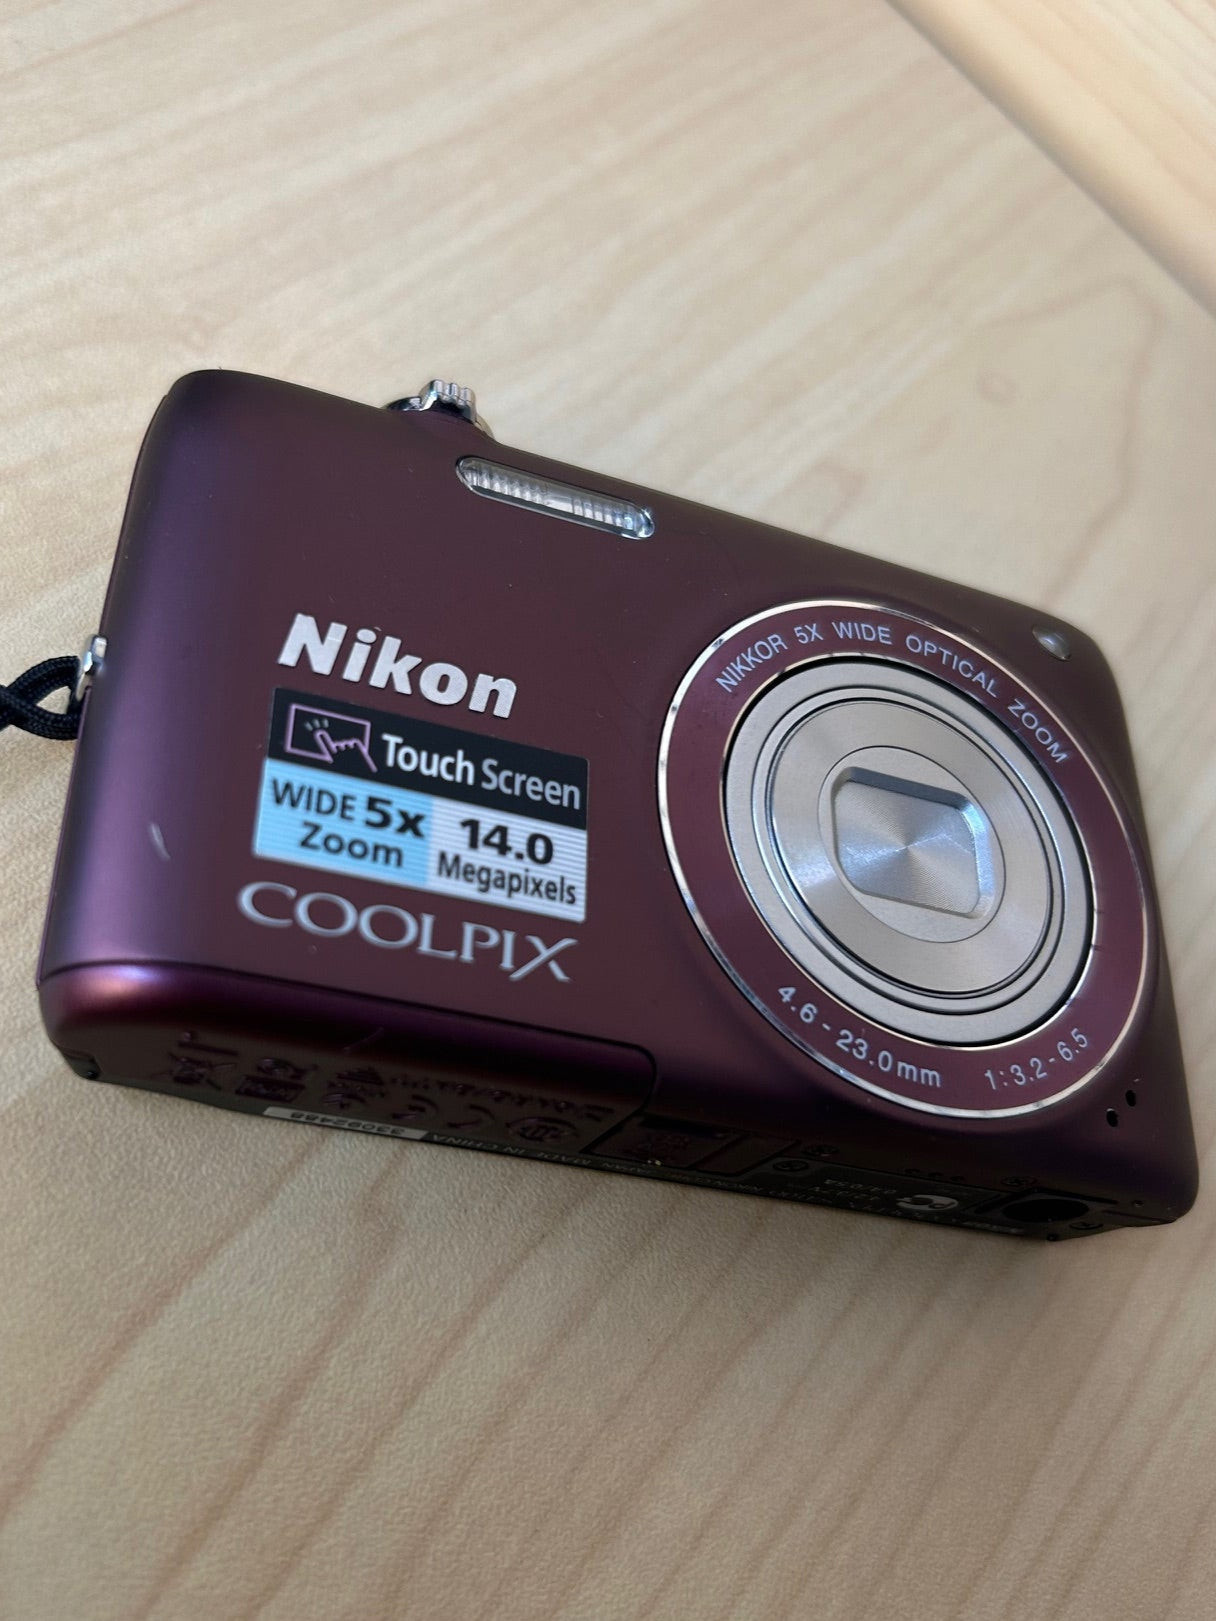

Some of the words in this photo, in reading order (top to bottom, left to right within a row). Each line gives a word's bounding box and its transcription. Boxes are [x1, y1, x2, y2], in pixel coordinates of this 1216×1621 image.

[277, 613, 518, 718] Nikon
[715, 633, 788, 693] NIKKOR
[794, 623, 824, 644] 5X
[831, 621, 892, 645] WIDE
[905, 634, 998, 698] OPTICAL
[1007, 698, 1068, 763] ZOOM
[381, 733, 475, 786] Touch
[481, 758, 581, 810] Screen
[271, 777, 358, 821] WIDE
[364, 796, 426, 839] 5x
[459, 817, 554, 865] 14.0
[300, 821, 402, 869] Zoom
[437, 851, 577, 905] Megapixels
[237, 881, 578, 982] COOLPIX
